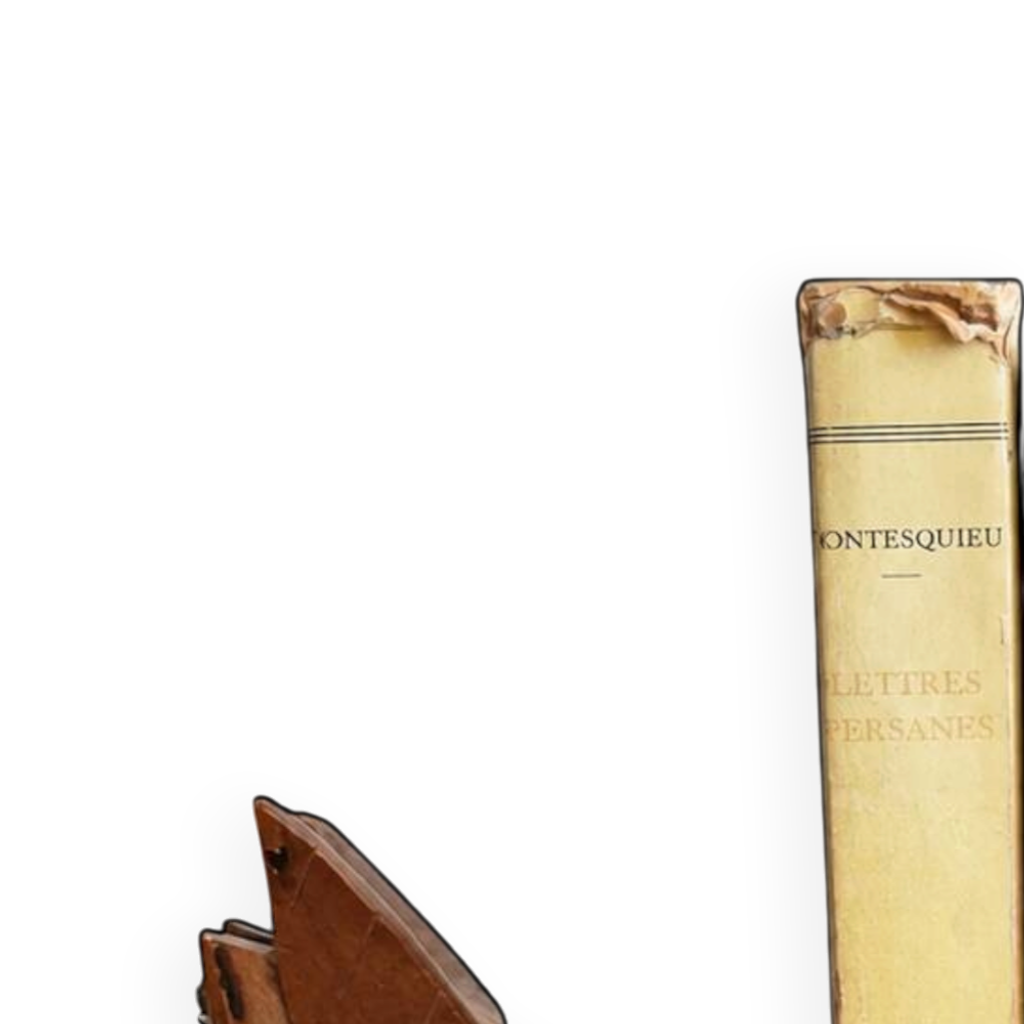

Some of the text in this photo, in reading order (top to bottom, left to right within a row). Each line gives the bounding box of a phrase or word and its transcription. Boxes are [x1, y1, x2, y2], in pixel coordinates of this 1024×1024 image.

[811, 526, 1002, 551] ONTESQUIEU
[830, 670, 981, 697] LETTRES
[825, 714, 995, 742] PERSANES
